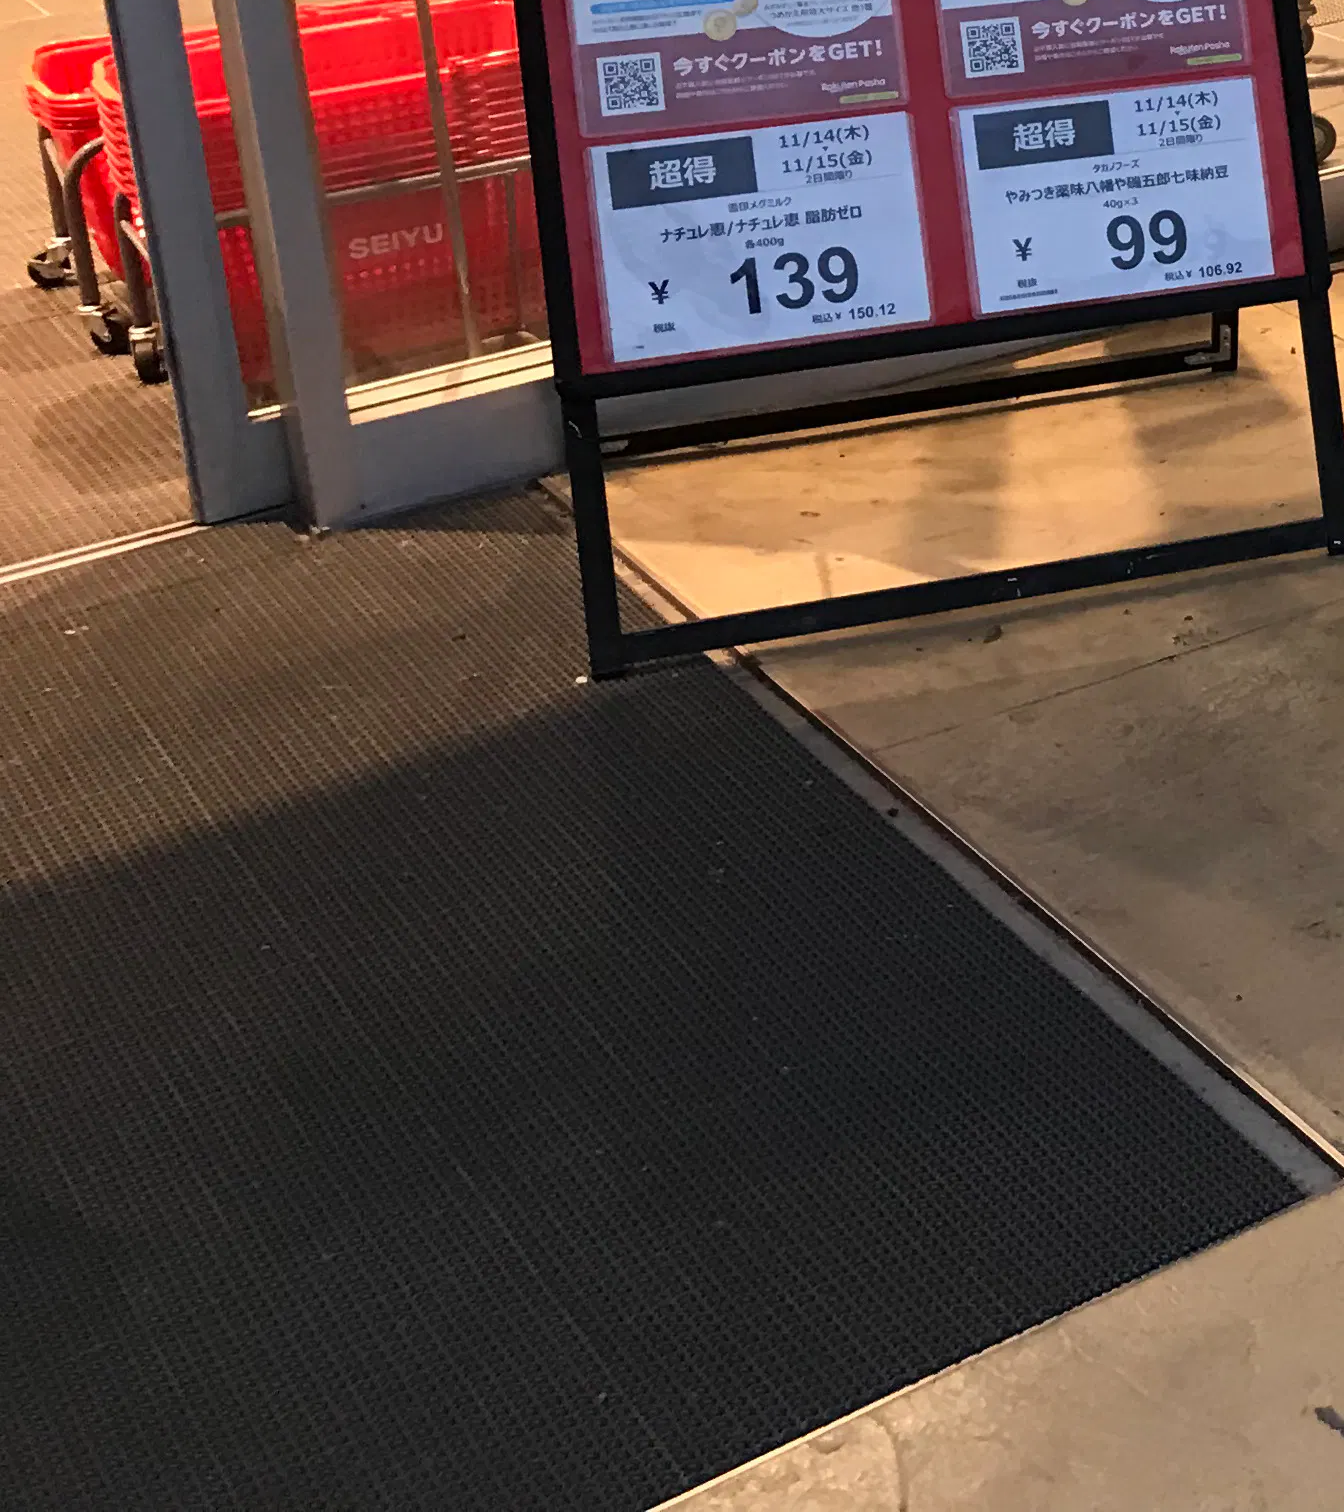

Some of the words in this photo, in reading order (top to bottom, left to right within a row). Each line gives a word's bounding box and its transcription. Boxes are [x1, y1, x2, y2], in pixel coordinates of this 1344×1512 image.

[1031, 4, 1227, 40] 今すぐクーポンをGET!
[673, 38, 884, 77] 今すぐクーポンをGET!
[1012, 118, 1076, 153] 超得
[1133, 89, 1220, 115] 11/14(木)
[1136, 113, 1222, 138] 11/15(金)
[649, 155, 717, 191] 超得
[779, 123, 870, 150] 11/14(木)
[781, 149, 874, 175] 11/15(金)
[1092, 158, 1140, 174] タカノフーズ
[805, 205, 863, 225] 脂肪ゼロ
[348, 223, 444, 260] SEIYU
[1105, 209, 1188, 271] 99
[729, 245, 860, 316] 139
[1198, 260, 1243, 280] 106.92
[848, 302, 897, 321] 150.12
